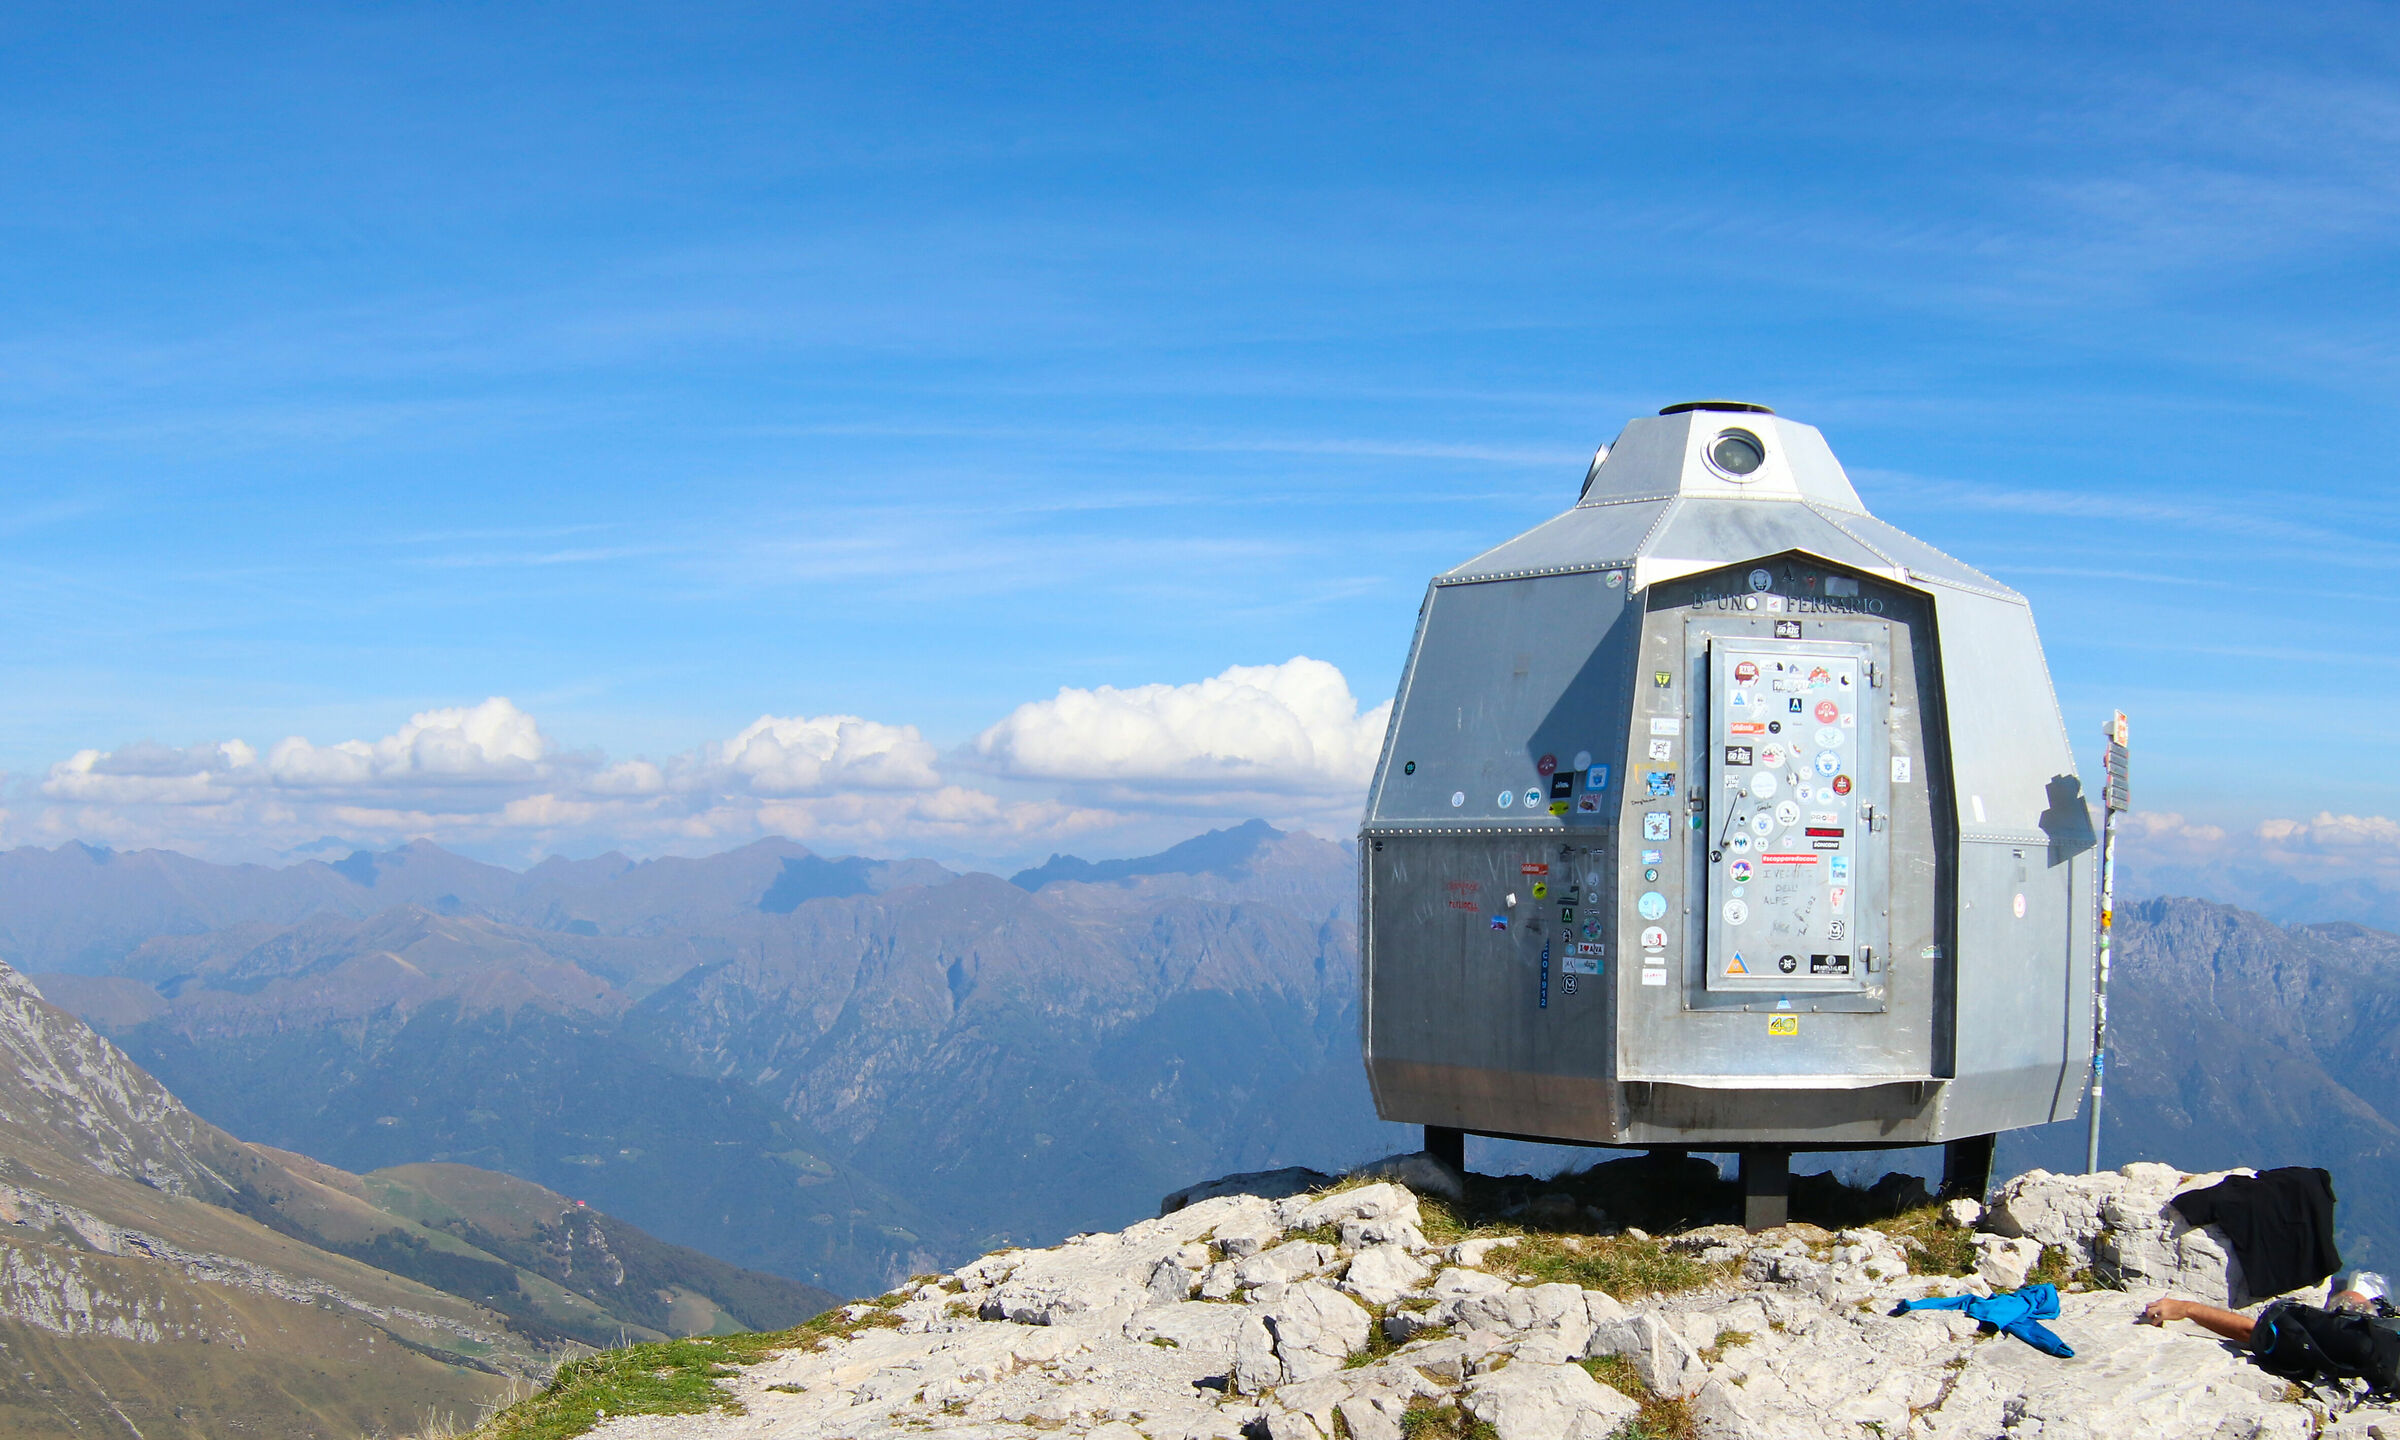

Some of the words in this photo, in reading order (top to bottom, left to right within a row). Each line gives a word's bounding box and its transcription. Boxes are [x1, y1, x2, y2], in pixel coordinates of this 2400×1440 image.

[1782, 565, 1795, 581] A
[1692, 592, 1758, 611] BUNO
[1786, 595, 1883, 614] FERRARIO
[1777, 626, 1787, 634] GO
[1787, 626, 1799, 635] BIG
[1728, 752, 1738, 760] GO
[1738, 752, 1750, 760] BIG
